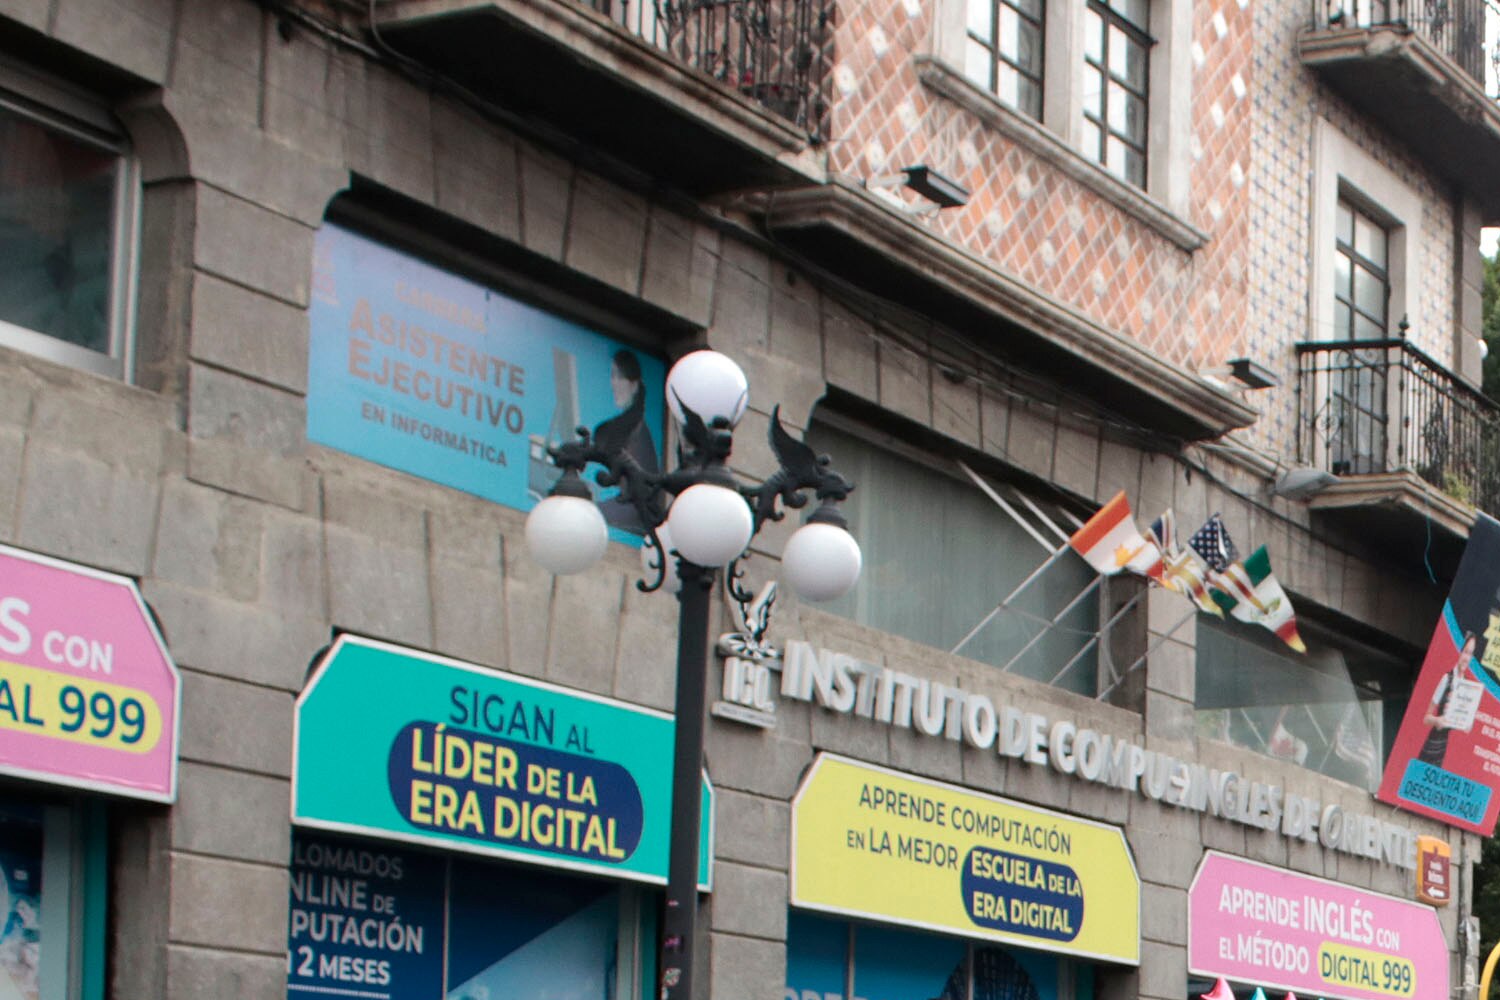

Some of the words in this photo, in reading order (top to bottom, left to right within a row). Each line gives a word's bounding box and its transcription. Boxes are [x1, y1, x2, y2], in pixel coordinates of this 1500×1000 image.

[350, 298, 526, 396] ASISTENTE
[348, 337, 525, 434] EJECUTIVO
[361, 401, 386, 426] EN
[43, 629, 114, 675] CON
[59, 684, 146, 744] 999
[449, 686, 555, 745] SIGAN
[565, 724, 595, 754] AL
[411, 722, 519, 791] LÍDER
[527, 764, 561, 800] DE
[567, 772, 598, 807] LA
[781, 639, 997, 749] INSTITUTO
[998, 706, 1048, 766] DE
[1319, 804, 1419, 870] ORIENTE
[1422, 766, 1461, 794] SOLICITA
[1460, 781, 1476, 799] TU
[410, 779, 485, 835] ERA
[494, 796, 625, 860] DIGITAL
[858, 783, 946, 827] APRENDE
[951, 806, 1071, 857] COMPUTACIÓN
[1403, 780, 1458, 811] DESCUENTO
[847, 829, 865, 850] EN
[869, 828, 893, 857] LA
[898, 834, 959, 871] MEJOR
[970, 850, 1046, 892] ESCUELA
[1047, 873, 1065, 895] DE
[1065, 877, 1082, 898] LA
[373, 894, 396, 915] DE
[973, 891, 1008, 925] ERA
[1010, 898, 1073, 935] DIGITAL
[1218, 884, 1301, 930] APRENDE
[1303, 896, 1374, 946] INGLÉS
[1376, 927, 1401, 951] CON
[297, 945, 315, 977] 2
[319, 953, 392, 986] MESES
[1219, 937, 1236, 961] EL
[1237, 930, 1311, 975] MÉTODO
[1322, 952, 1379, 988] DIGITAL
[1382, 961, 1412, 994] 999
